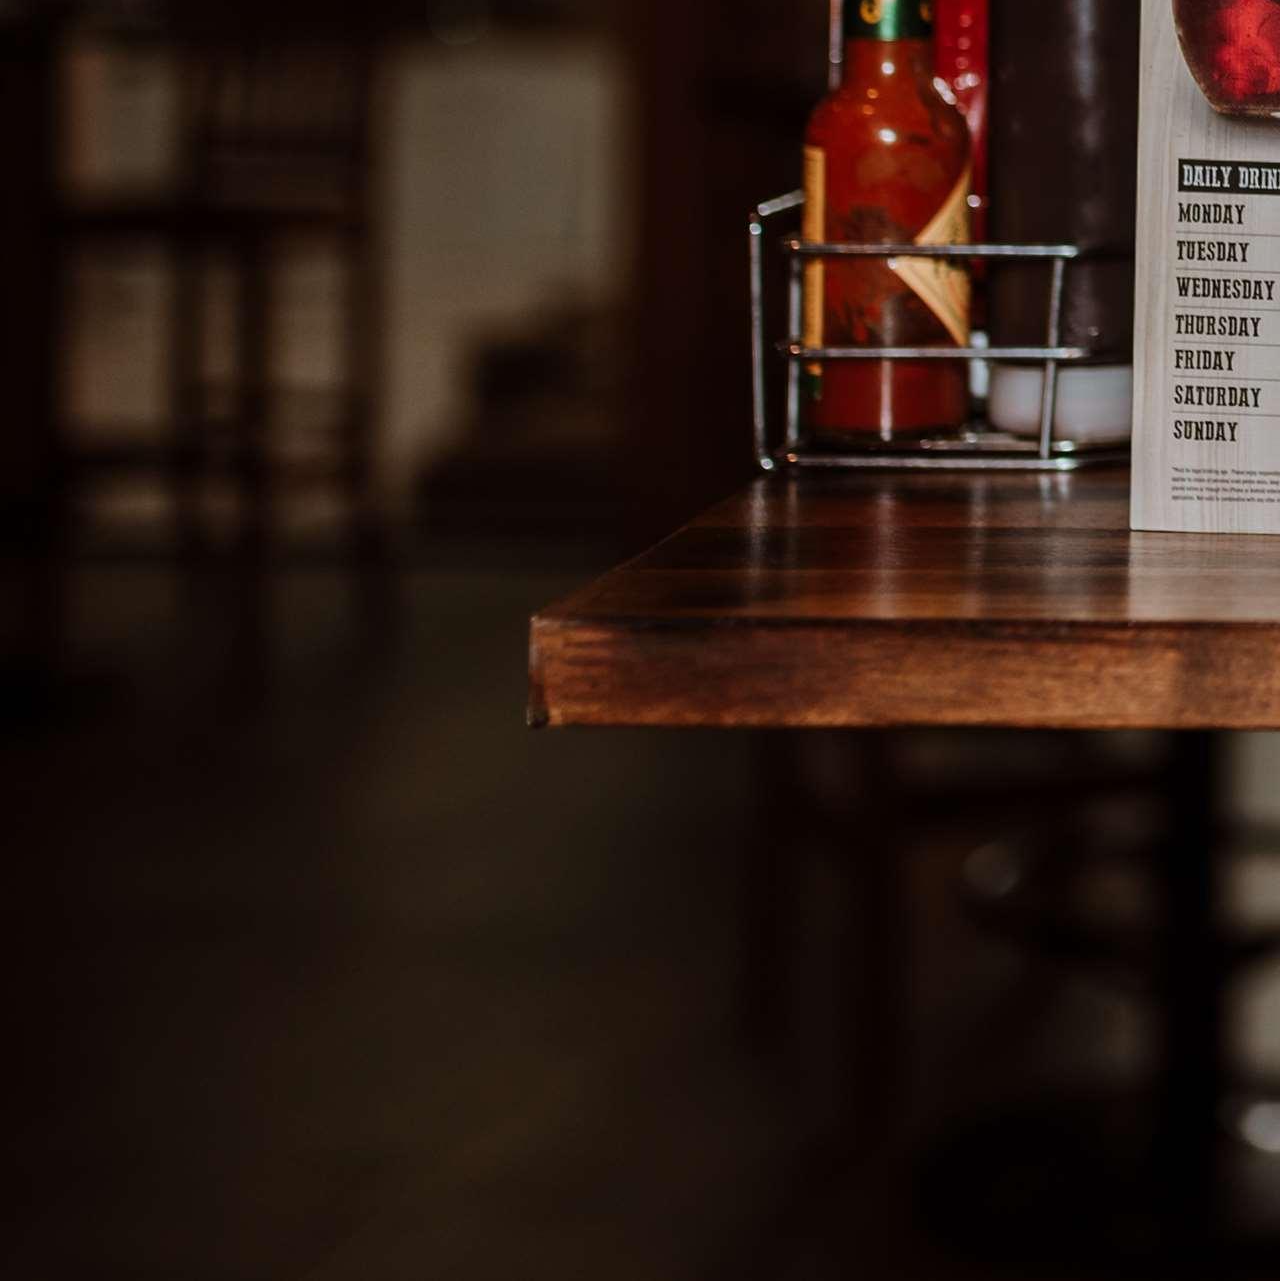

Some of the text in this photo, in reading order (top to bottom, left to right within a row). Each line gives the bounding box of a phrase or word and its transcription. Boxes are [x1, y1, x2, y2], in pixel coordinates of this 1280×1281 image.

[1182, 164, 1233, 188] DAILY
[1178, 203, 1245, 225] MONDAY
[1176, 240, 1250, 262] TUESDAY
[1176, 277, 1276, 300] WEDNESDAY
[1175, 314, 1262, 337] THURSDAY
[1174, 349, 1236, 371] FRIDAY
[1174, 385, 1262, 408] SATURDAY
[1173, 420, 1239, 442] SUNDAY
